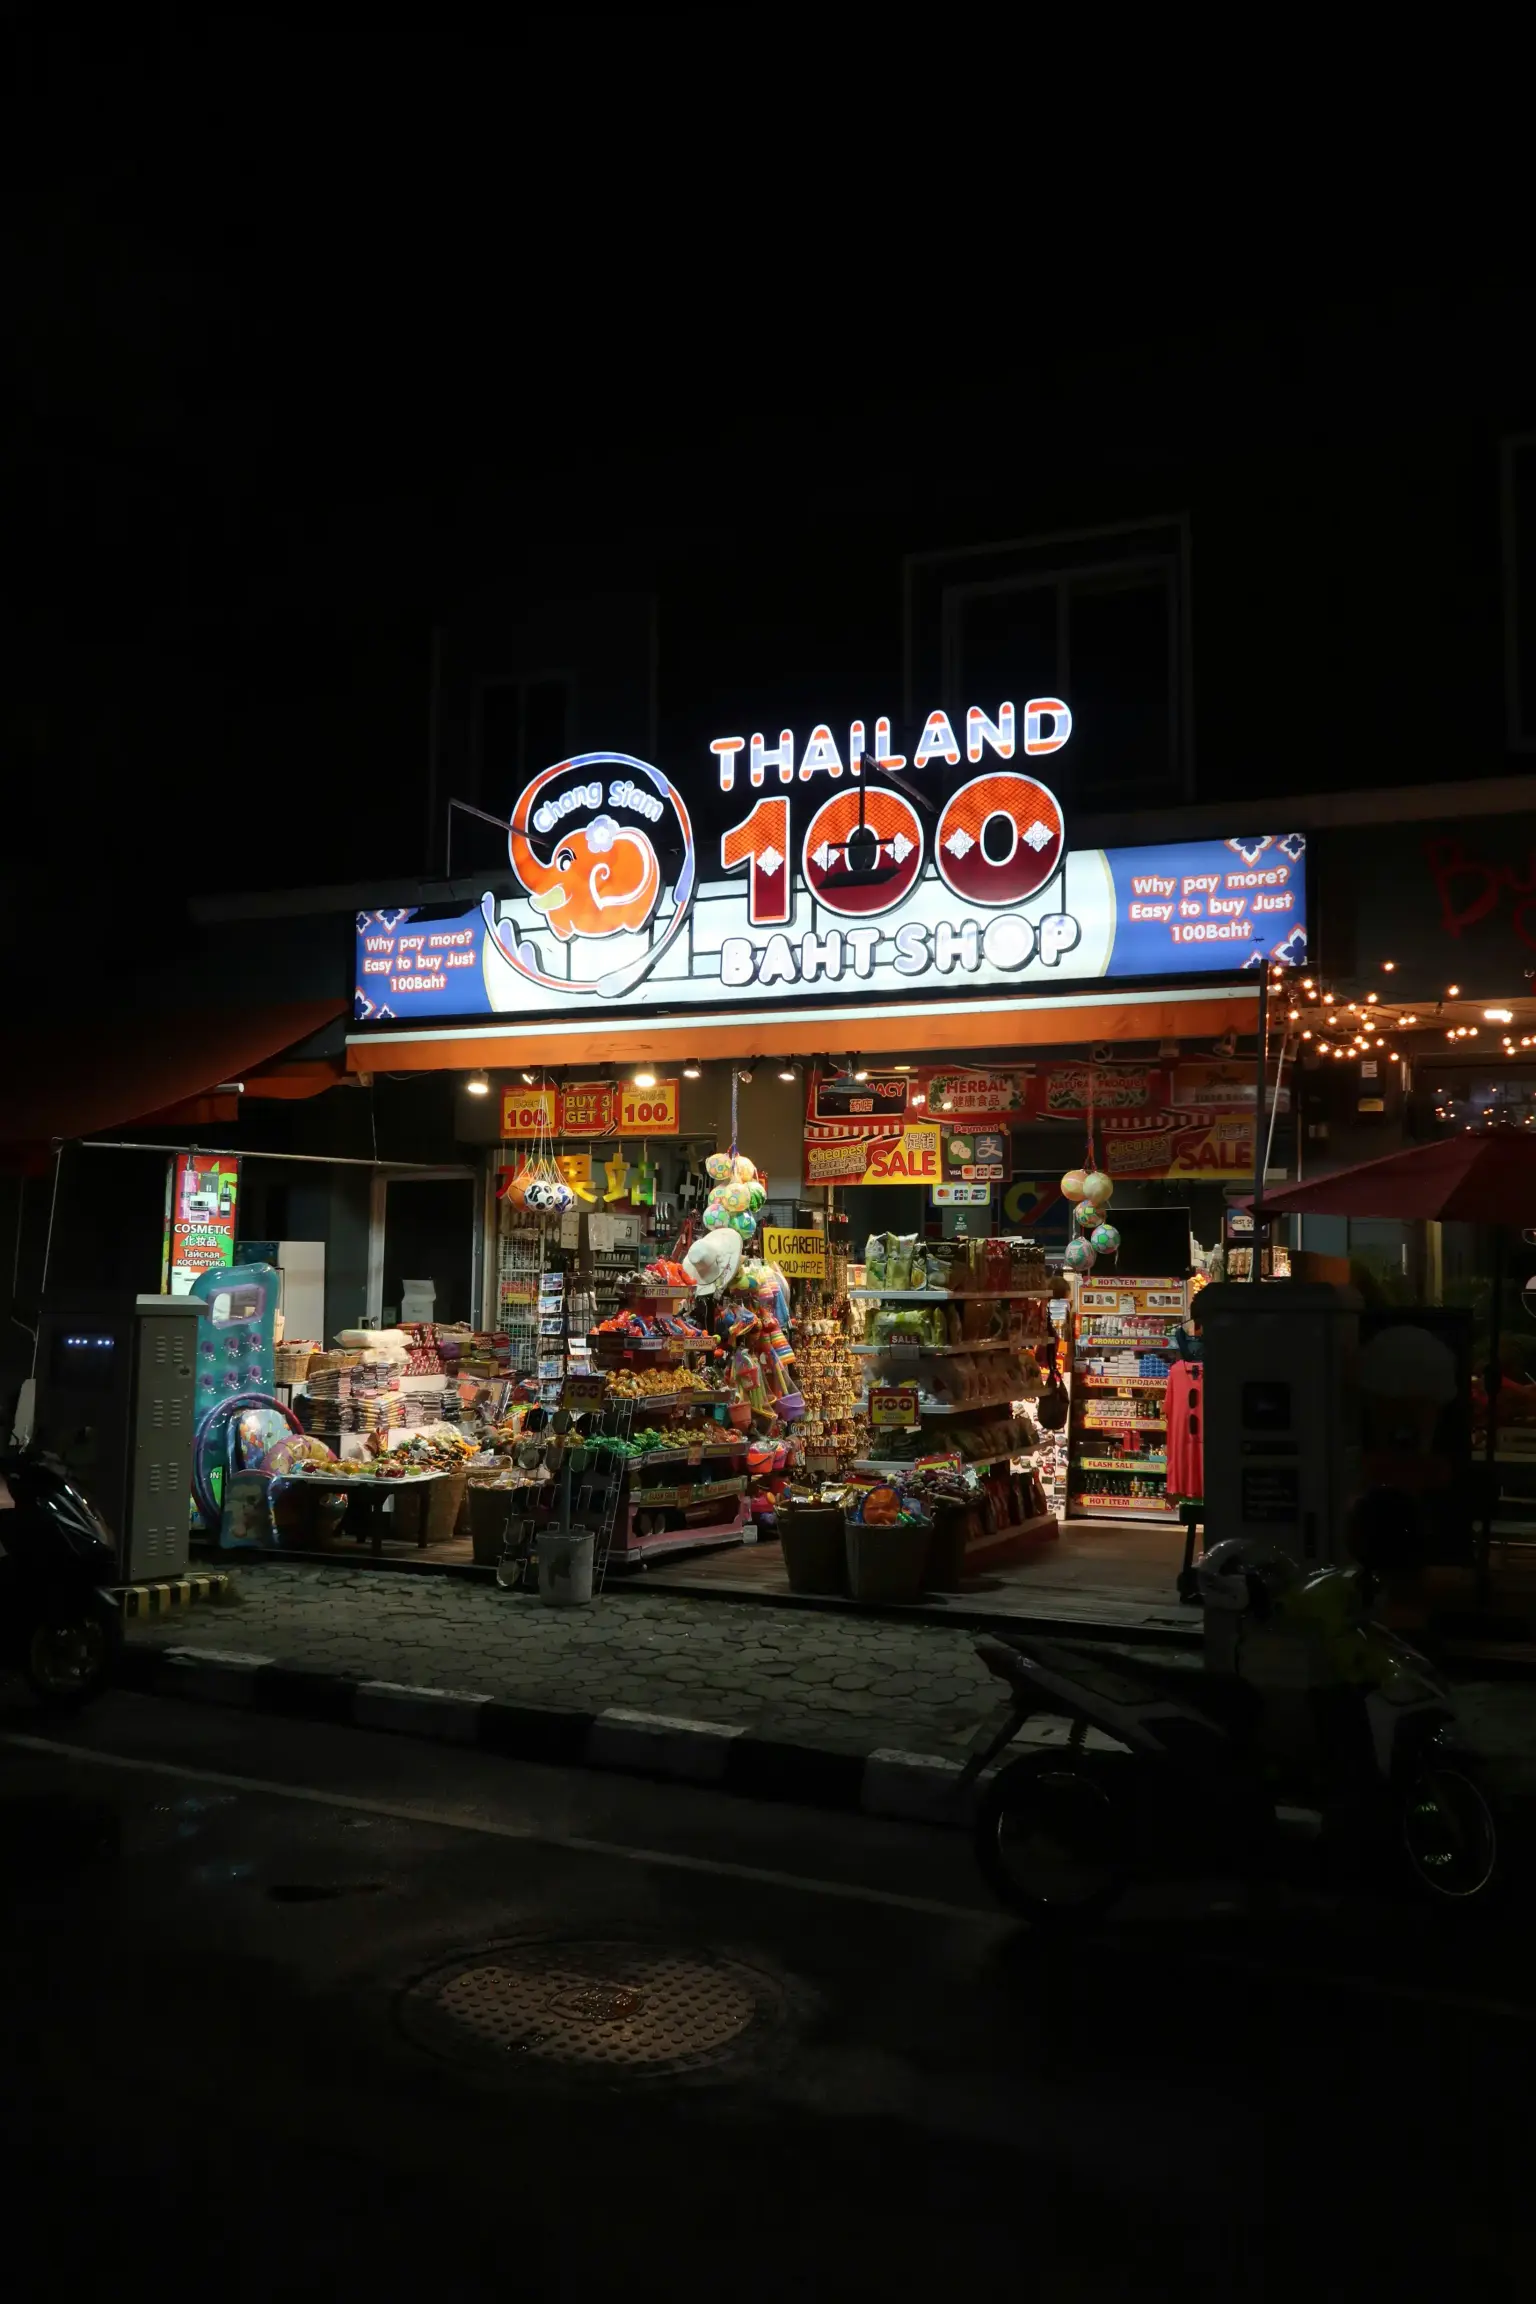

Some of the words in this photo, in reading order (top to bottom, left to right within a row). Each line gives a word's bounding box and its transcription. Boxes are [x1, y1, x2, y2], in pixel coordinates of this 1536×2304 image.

[709, 697, 1073, 792] THAILAND
[533, 782, 602, 832] Chang
[608, 780, 664, 822] Siam
[721, 772, 1065, 926] 100
[1133, 877, 1175, 897] Why
[1183, 875, 1219, 895] pay
[1227, 867, 1288, 888] more?
[1131, 904, 1173, 920] Easy
[1180, 900, 1201, 916] to
[1209, 898, 1245, 916] buy
[1253, 893, 1293, 912] Just
[1172, 922, 1252, 942] 100Baht
[366, 937, 395, 952] Why
[399, 936, 424, 951] pay
[430, 931, 473, 946] more?
[720, 927, 885, 987] BAHT
[893, 912, 1083, 976] SHOP
[364, 959, 392, 974] Easy
[397, 957, 411, 970] to
[416, 955, 442, 970] buy
[447, 951, 475, 967] Just
[390, 975, 446, 991] 100Baht
[946, 1080, 1007, 1094] HERBAL
[565, 1095, 597, 1108] BUY
[601, 1094, 610, 1108] 3
[849, 1098, 874, 1113] 药店
[952, 1094, 1001, 1108] 健康食品
[565, 1110, 597, 1124] GET
[601, 1110, 609, 1123] 1
[953, 1123, 999, 1135] Payment
[904, 1131, 937, 1150] 促销
[808, 1141, 869, 1163] Cheapest
[1178, 1141, 1253, 1170] SALE
[871, 1149, 937, 1177] SALE
[174, 1223, 231, 1235] COSMETIC
[184, 1235, 218, 1247] 化妆品
[768, 1234, 826, 1254] CIGARETTE
[183, 1248, 220, 1259] Тайская
[177, 1258, 226, 1267] косметика
[778, 1260, 799, 1273] SOLD
[800, 1260, 823, 1274] HERE
[1115, 1279, 1137, 1287] TEM
[891, 1335, 918, 1344] SALE
[1092, 1338, 1138, 1346] PROMOTION
[1126, 1379, 1168, 1387] ПРОДАЖА
[568, 1383, 599, 1399] 100
[874, 1397, 913, 1412] 100
[1111, 1419, 1132, 1428] ITEM
[807, 1446, 835, 1456] SALE
[1089, 1497, 1106, 1505] HOT
